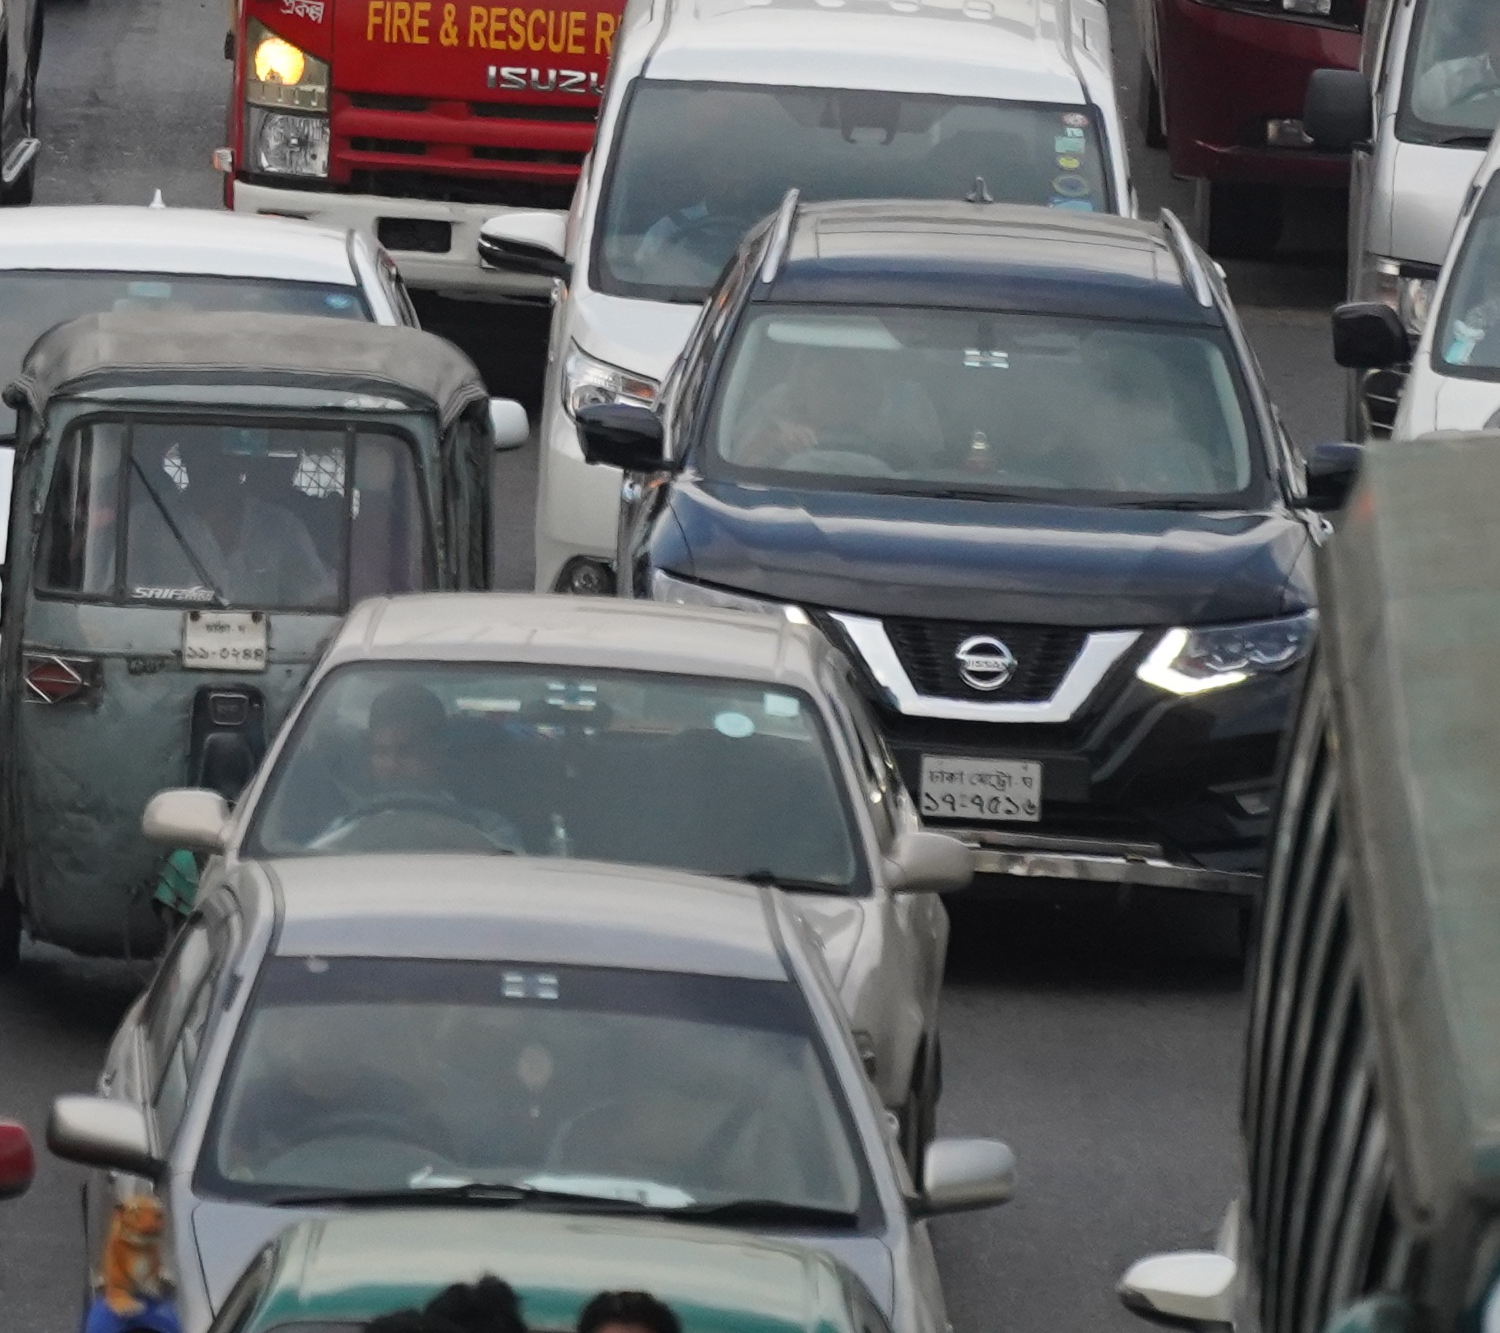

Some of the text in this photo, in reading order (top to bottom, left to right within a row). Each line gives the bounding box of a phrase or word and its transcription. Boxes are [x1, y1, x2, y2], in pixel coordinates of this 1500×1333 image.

[366, 0, 431, 45] FIRE
[439, 3, 459, 47] &
[468, 5, 588, 55] RESCUE
